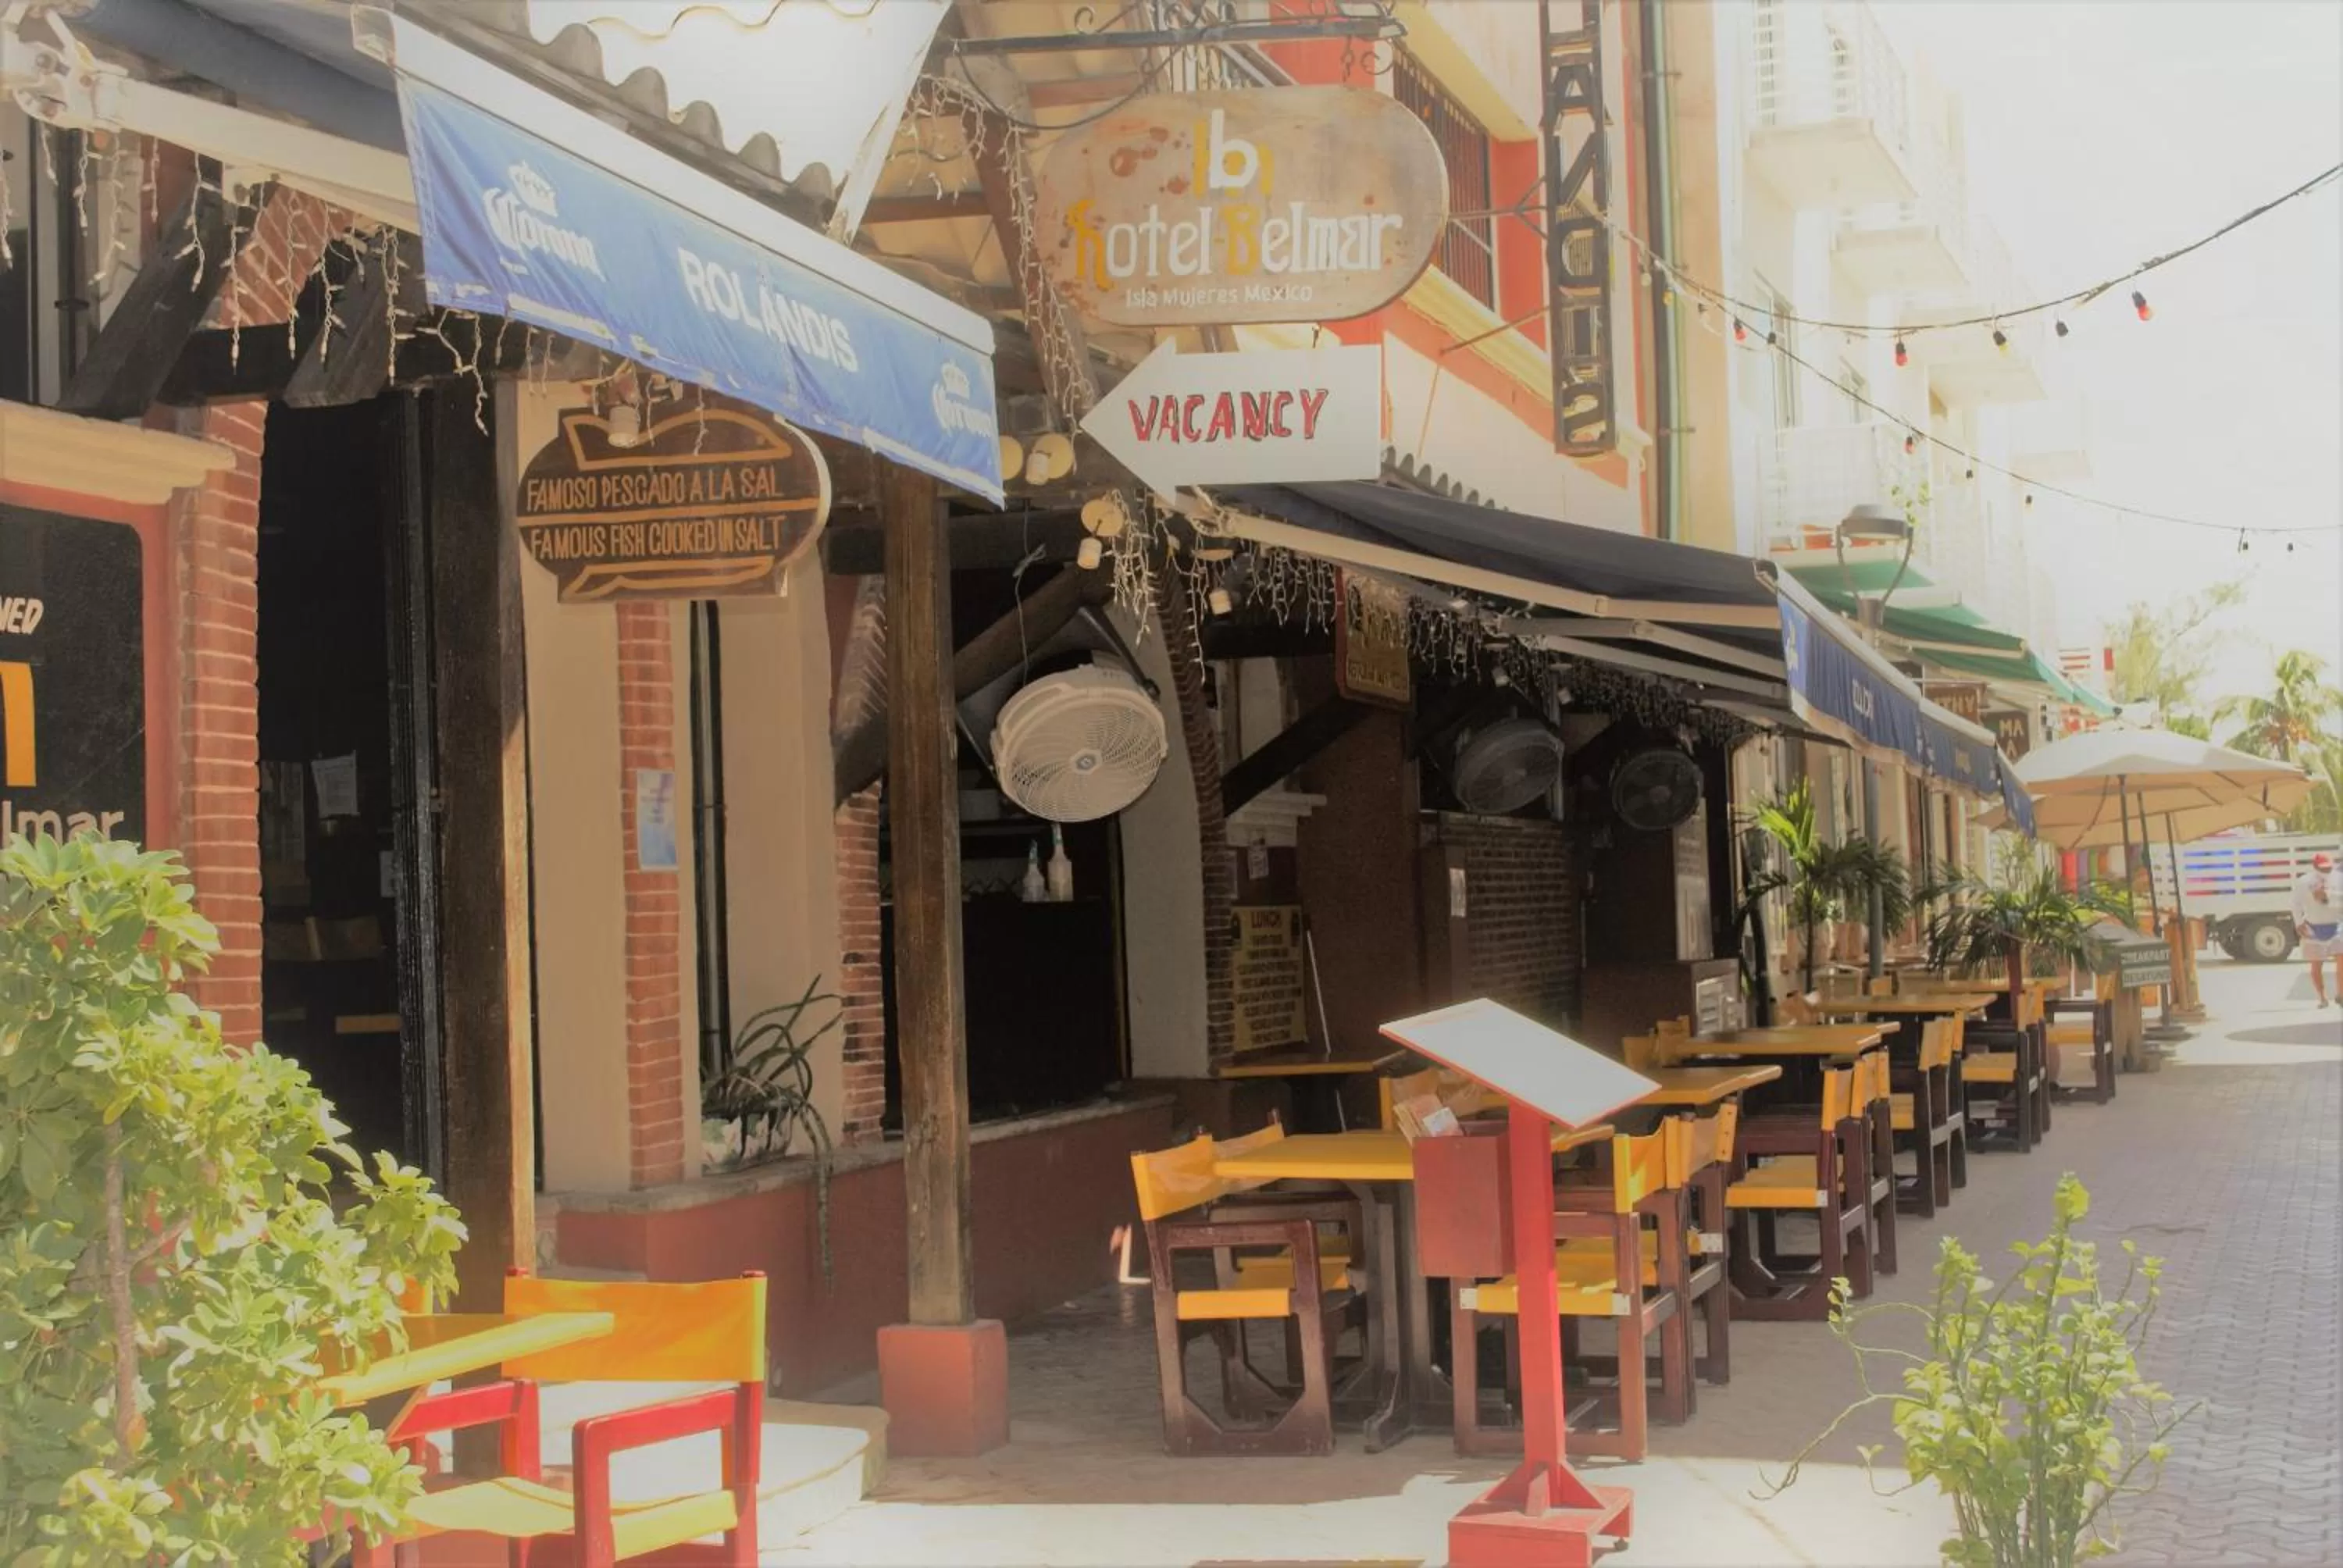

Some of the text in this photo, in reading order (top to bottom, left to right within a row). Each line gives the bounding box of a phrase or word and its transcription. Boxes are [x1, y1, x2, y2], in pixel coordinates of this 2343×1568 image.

[1218, 201, 1403, 274] Belmar
[677, 246, 858, 373] ROLANDIS
[1125, 283, 1314, 309] Isla Mujeres Mexico
[1127, 389, 1329, 444] VACANCY
[526, 465, 785, 513] FAMOSO PESCADO A LA SAL
[530, 514, 788, 560] FAMOUS FISH COOKED IN SALT
